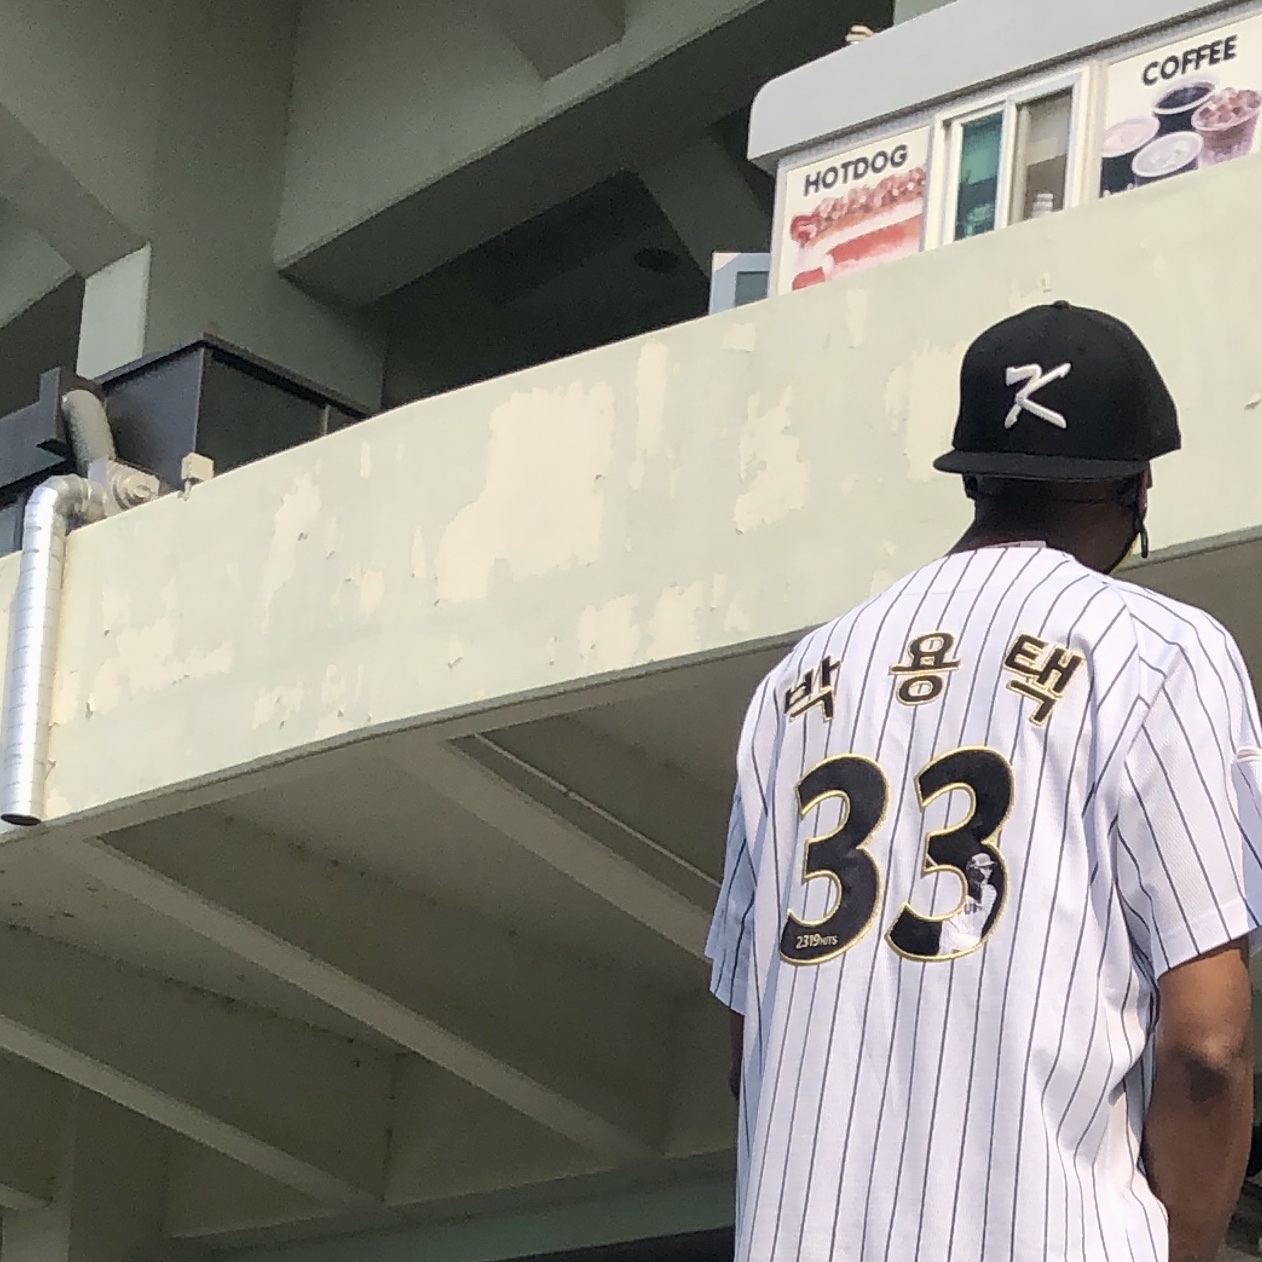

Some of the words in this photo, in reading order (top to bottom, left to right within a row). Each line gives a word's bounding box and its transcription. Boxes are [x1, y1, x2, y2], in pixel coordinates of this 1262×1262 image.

[1143, 34, 1237, 86] COFFEE
[803, 144, 908, 197] HOTDOG
[780, 745, 1016, 965] 33
